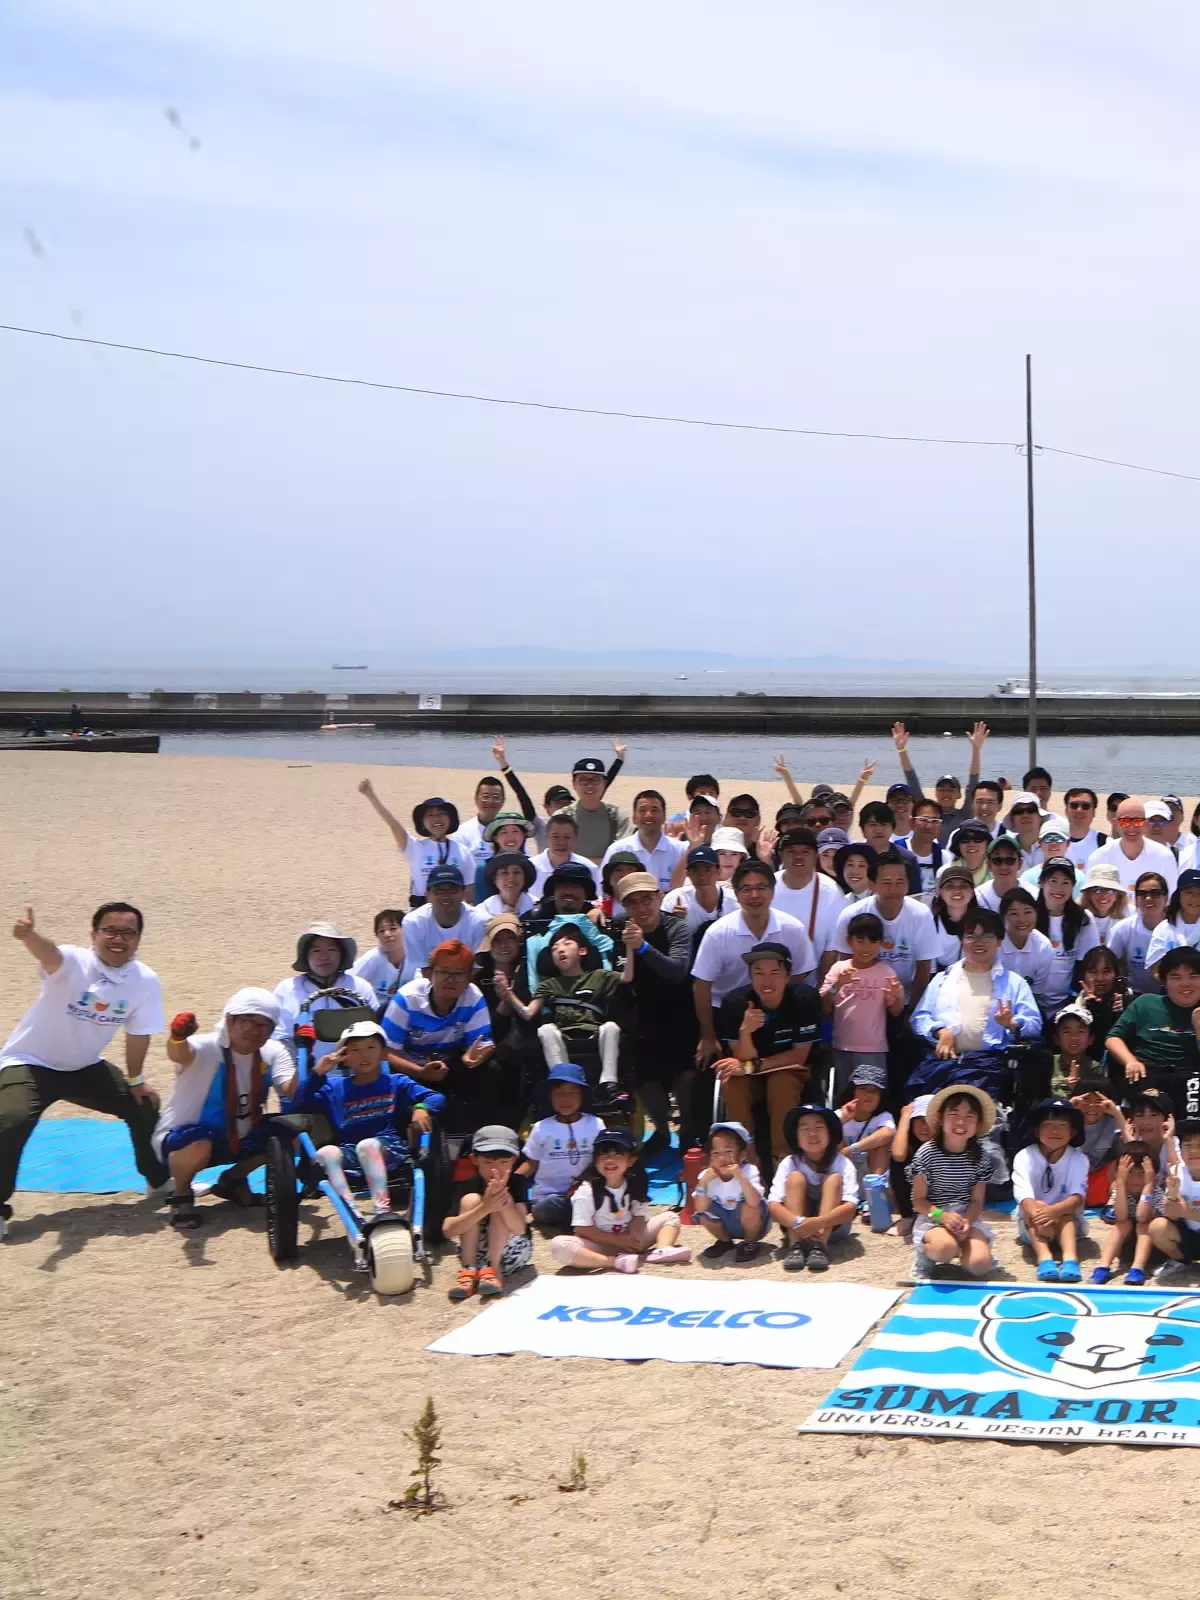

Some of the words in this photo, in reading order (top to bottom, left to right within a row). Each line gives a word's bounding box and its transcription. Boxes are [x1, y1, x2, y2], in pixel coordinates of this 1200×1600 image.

[536, 1305, 812, 1329] KOBELCO
[831, 1385, 1024, 1420] SUMA
[1050, 1399, 1179, 1425] FOR
[818, 1412, 970, 1430] UNIVERSAL
[984, 1424, 1083, 1436] DESIGN
